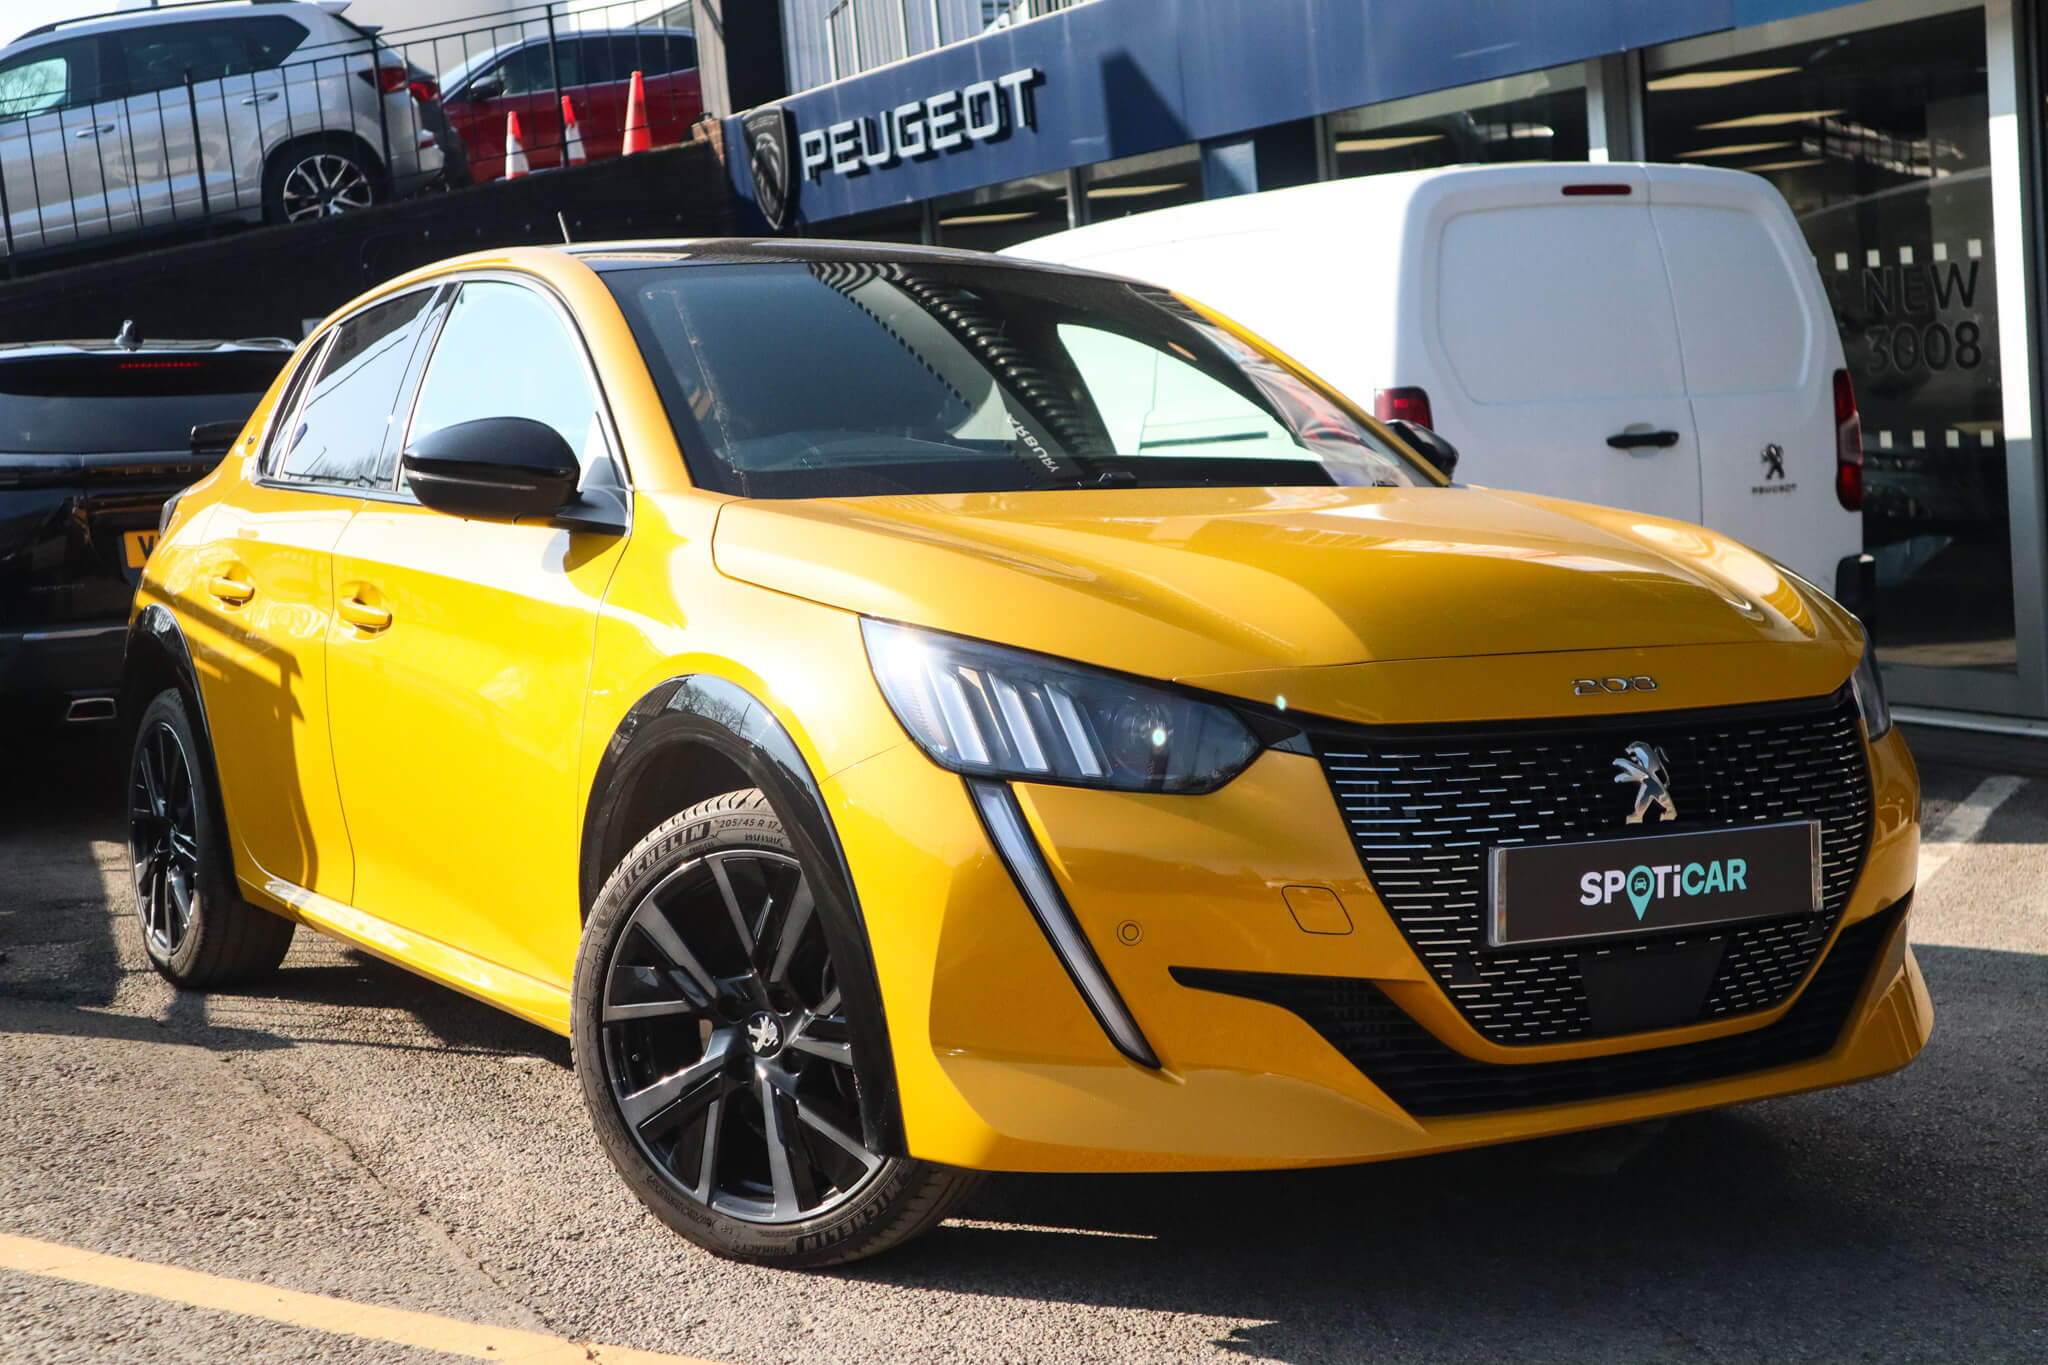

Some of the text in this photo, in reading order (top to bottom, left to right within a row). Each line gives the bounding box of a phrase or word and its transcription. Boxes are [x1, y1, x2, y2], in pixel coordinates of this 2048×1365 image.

[800, 68, 1036, 182] PEUGEOT
[1861, 260, 1979, 314] NEW
[1864, 320, 1982, 375] 3008
[719, 817, 779, 830] 205/45 R 17
[613, 822, 706, 899] MICHELIN
[803, 1177, 904, 1252] MICHELIN
